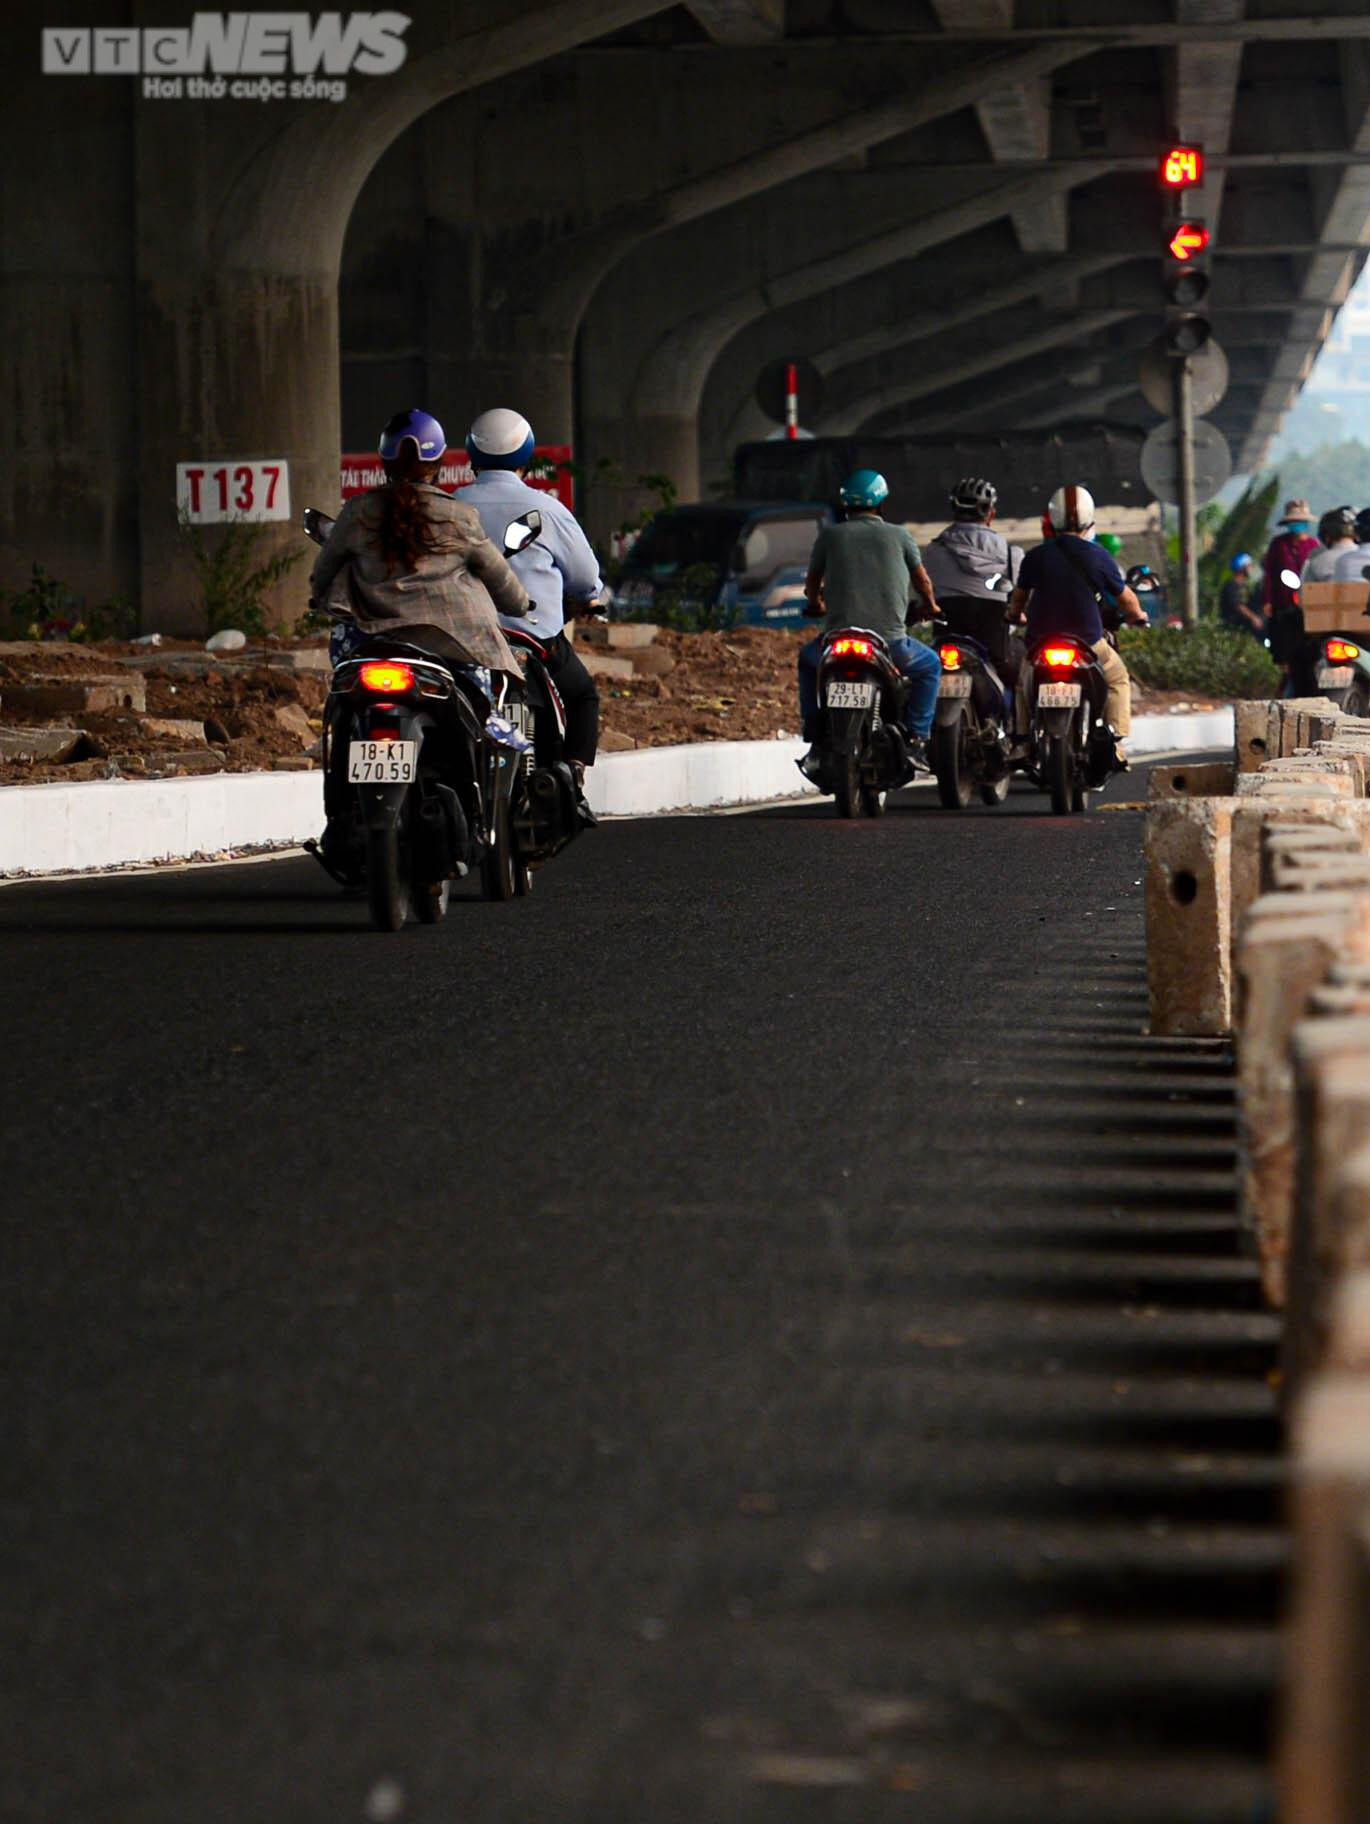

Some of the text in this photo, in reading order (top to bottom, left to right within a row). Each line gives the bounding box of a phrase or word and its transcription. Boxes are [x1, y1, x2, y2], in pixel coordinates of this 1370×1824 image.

[1165, 151, 1197, 182] 64
[185, 466, 280, 513] T137
[361, 743, 404, 760] 18-K1
[351, 762, 411, 780] 470.59
